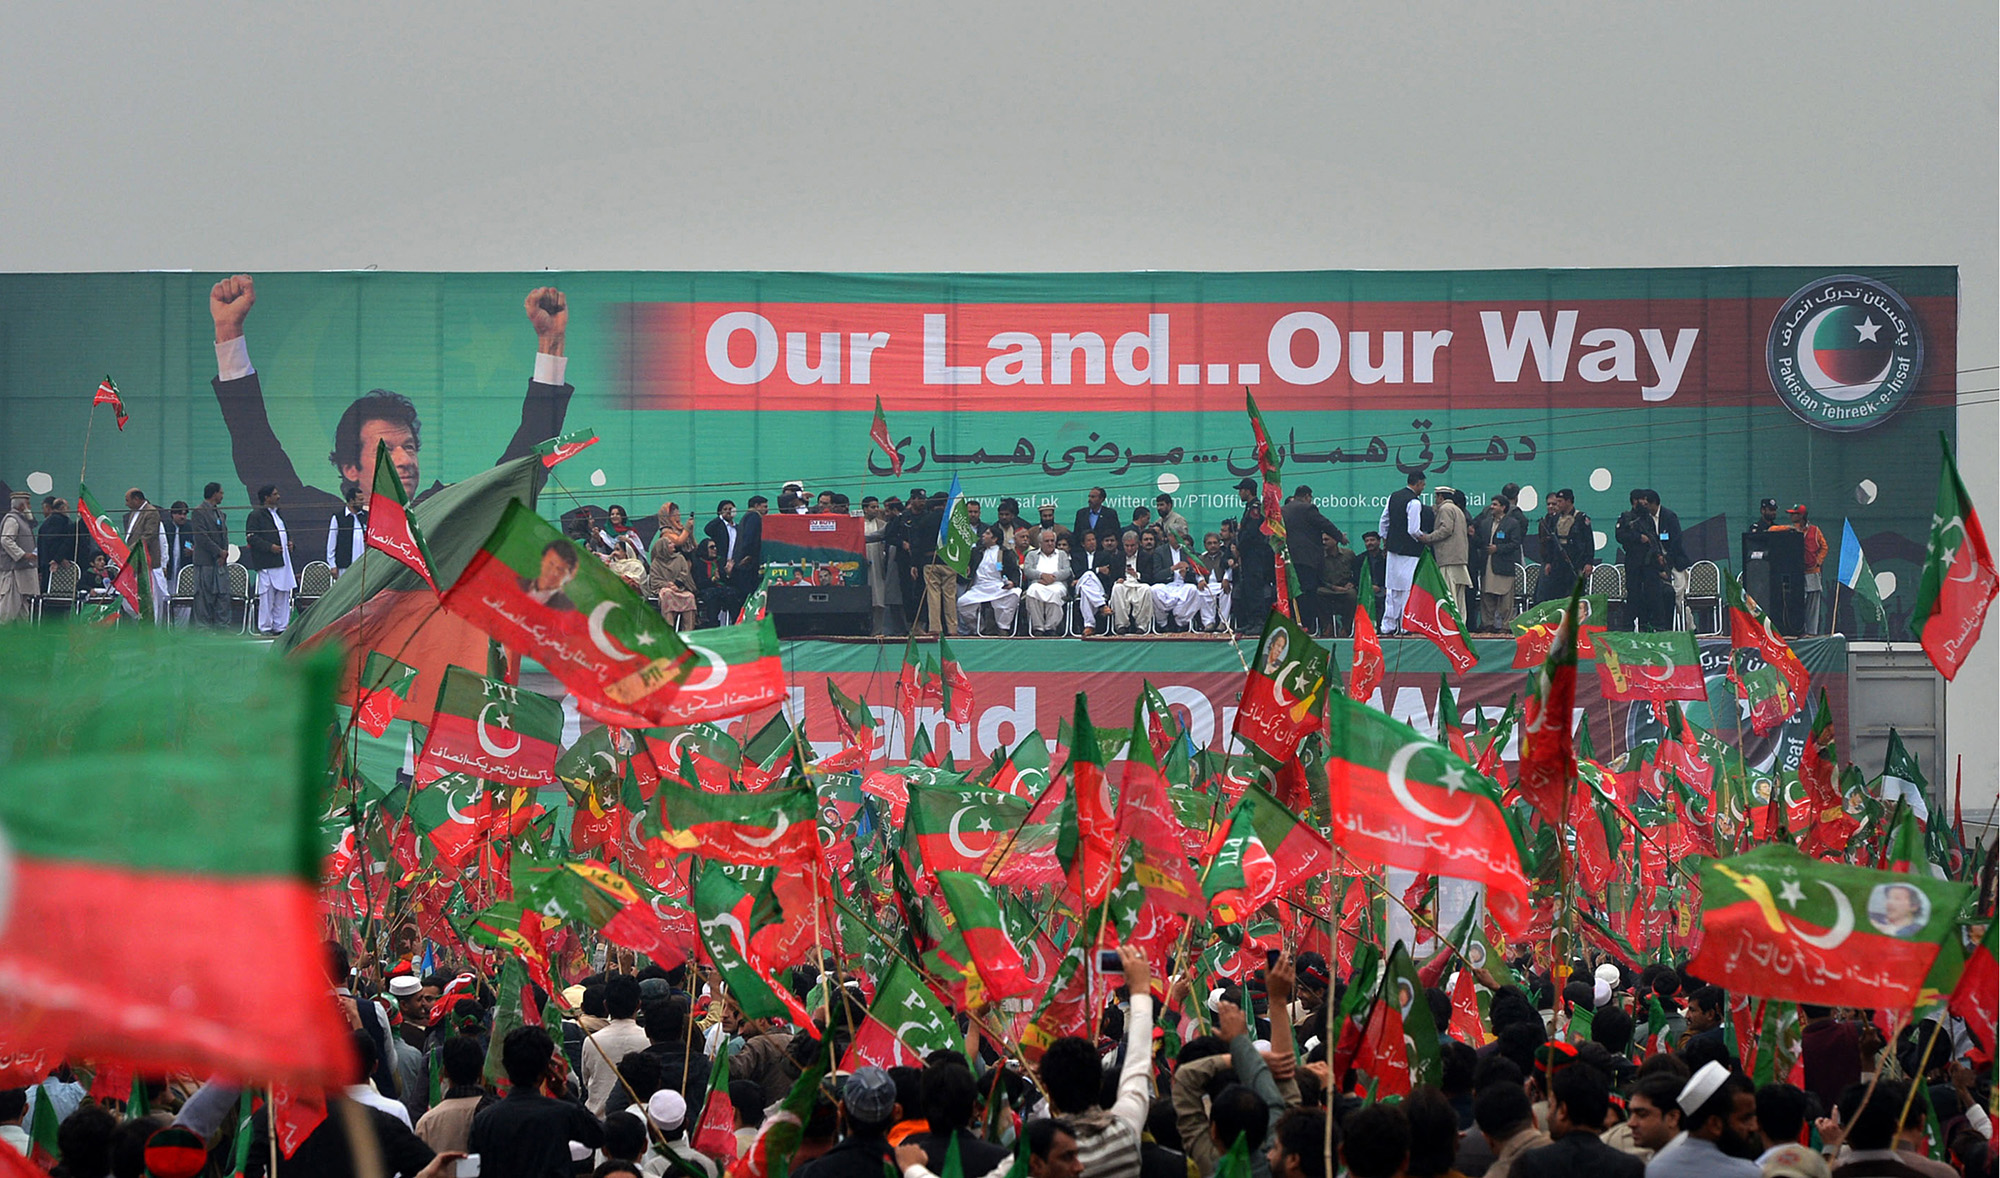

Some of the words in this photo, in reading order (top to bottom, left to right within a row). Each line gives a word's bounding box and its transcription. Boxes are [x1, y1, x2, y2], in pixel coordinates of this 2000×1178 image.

[1815, 286, 1863, 304] تحریک
[1781, 299, 1814, 347] انصاف
[1863, 291, 1909, 347] پاکستان
[704, 311, 890, 385] Our
[1480, 310, 1698, 402] Way
[1778, 356, 1819, 413] Pakistan
[1821, 355, 1911, 420] Tehreek-e-Insaf
[963, 494, 1059, 509] www.isaf.pk
[771, 568, 788, 577] PTI
[480, 678, 519, 705] PTI
[687, 723, 720, 742] PTI
[1700, 732, 1729, 756] PTI
[429, 746, 468, 765] انصاف
[466, 755, 509, 775] تحریک
[507, 765, 553, 785] پاکستان
[825, 774, 852, 787] PTI
[959, 790, 1006, 806] PTI
[1335, 813, 1408, 847] انصاف
[1217, 836, 1244, 867] PTI
[1408, 831, 1490, 863] تحریک
[901, 988, 955, 1050] PTI
